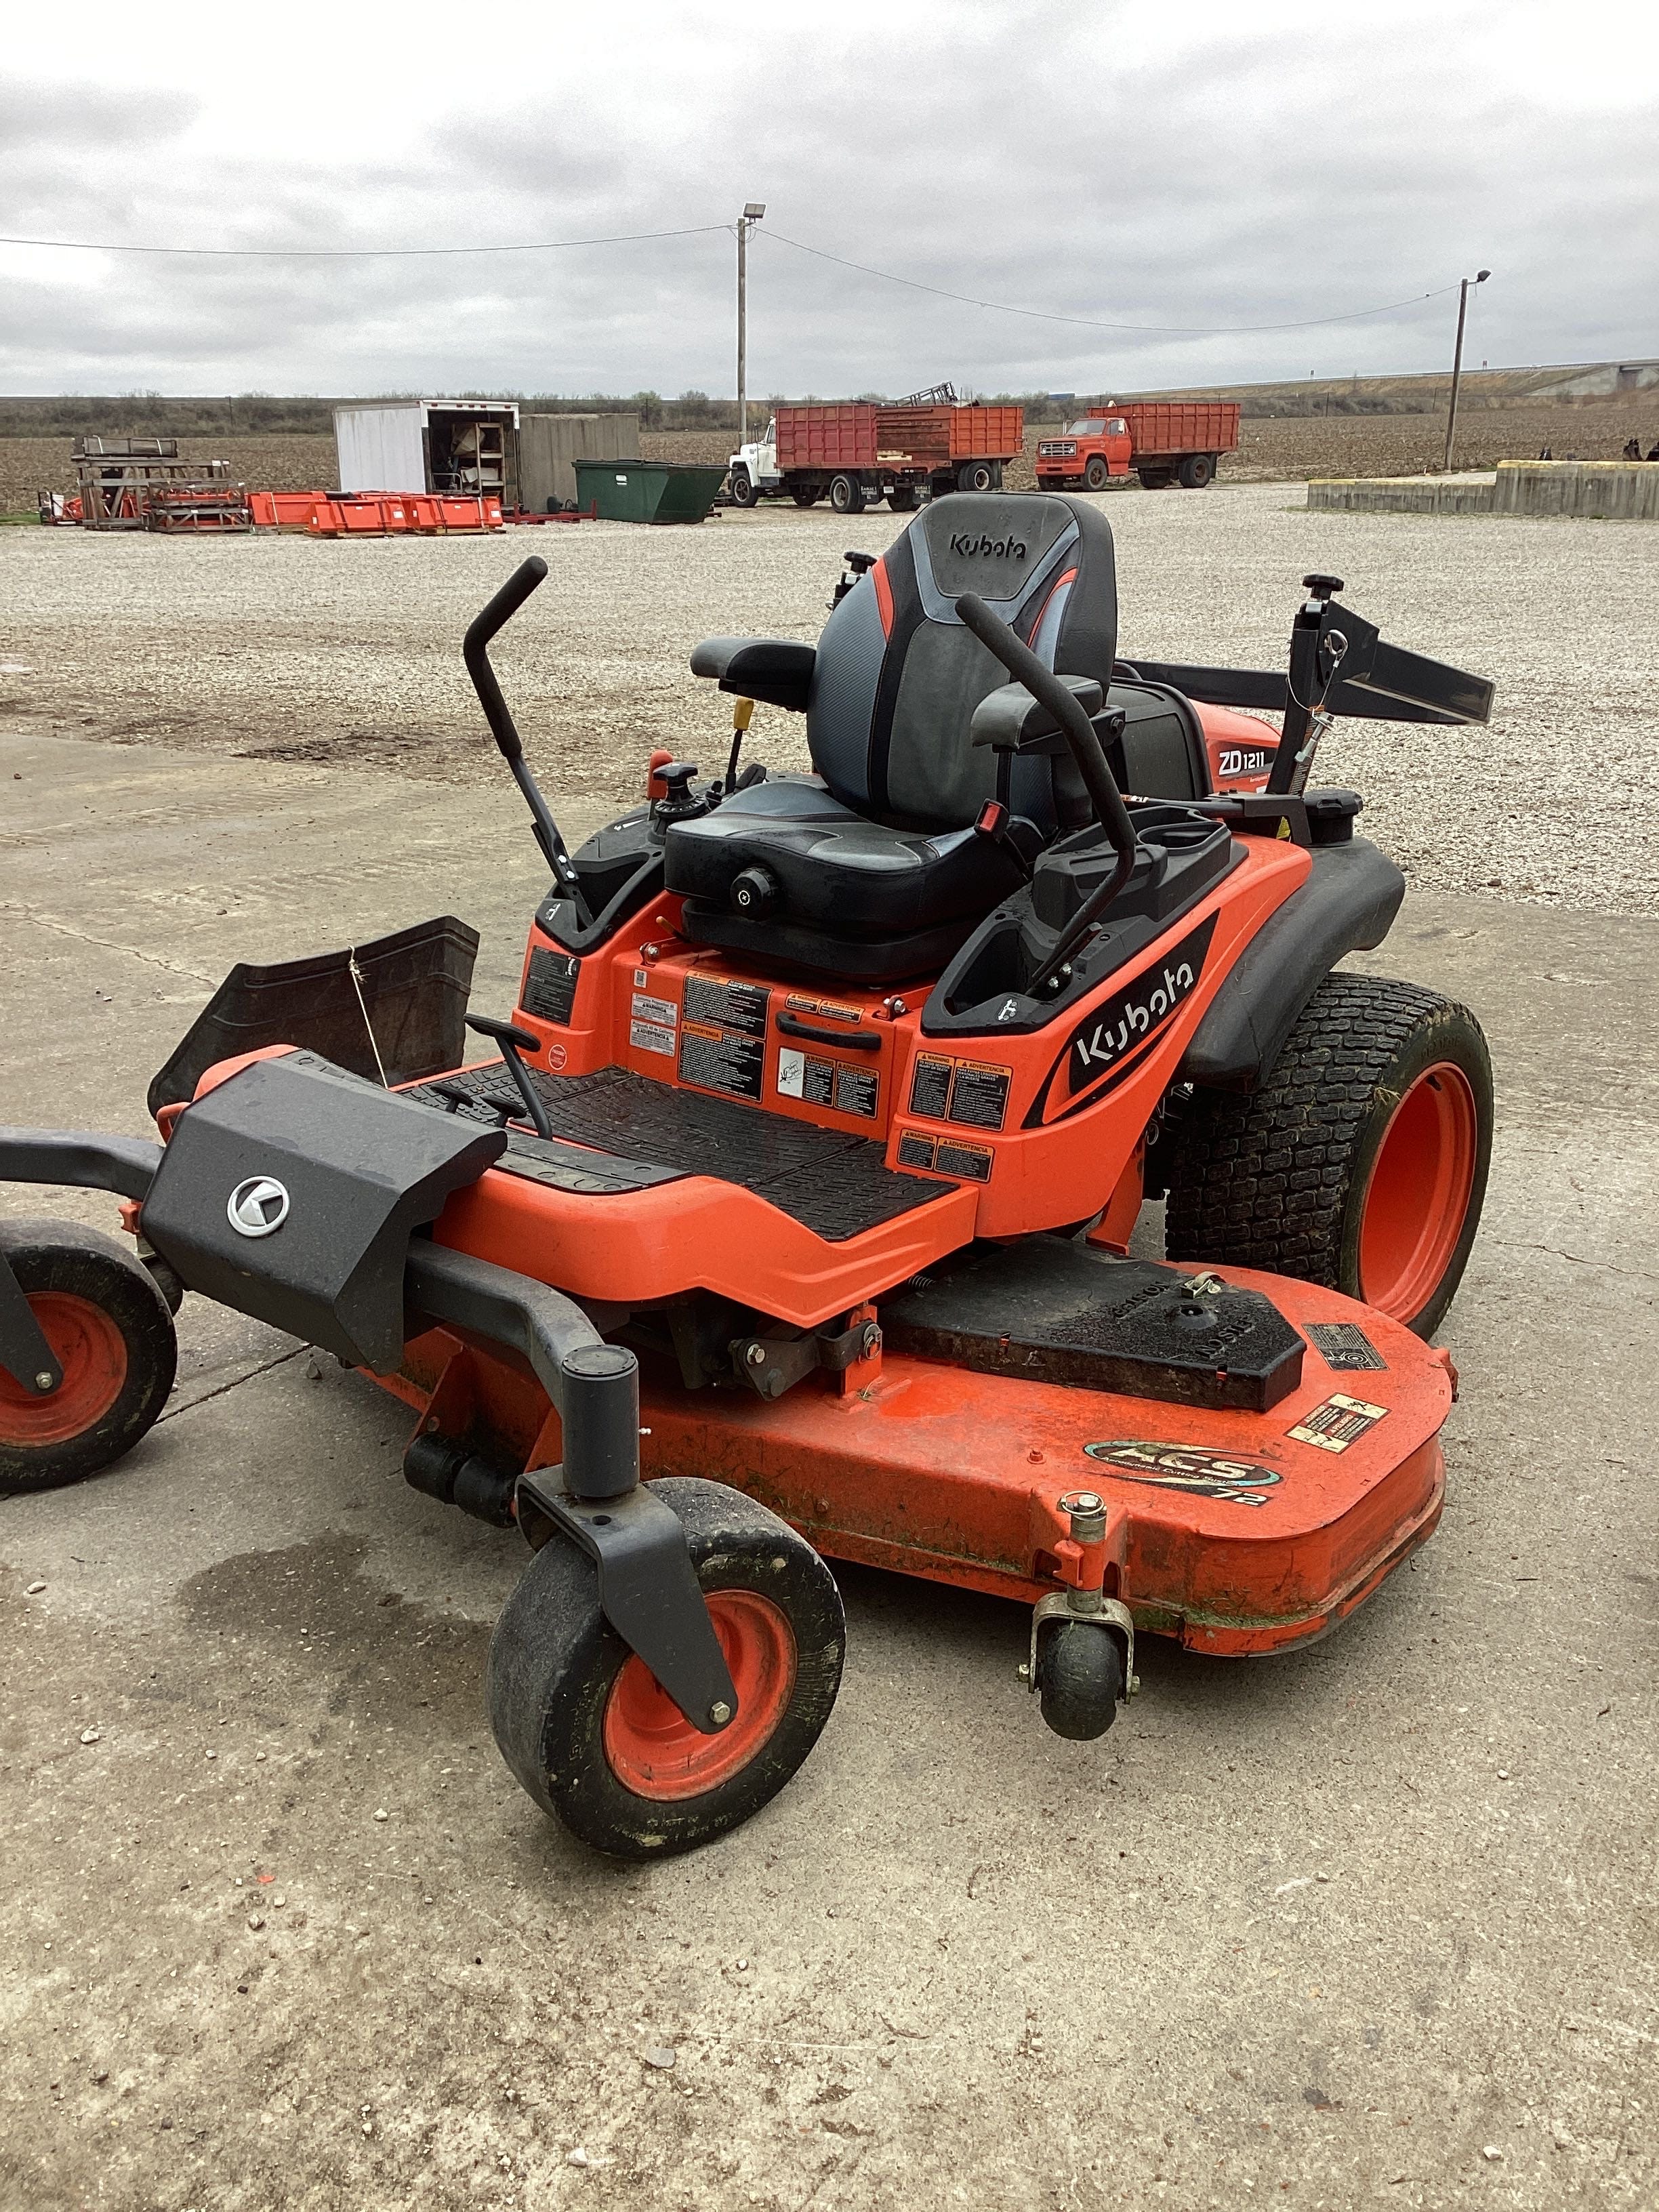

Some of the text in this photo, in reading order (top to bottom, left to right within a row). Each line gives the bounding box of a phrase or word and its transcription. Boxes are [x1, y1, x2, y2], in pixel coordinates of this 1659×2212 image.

[949, 533, 1027, 559] Kubota
[1218, 750, 1265, 775] ZD 1211
[1076, 963, 1194, 1065] Kubota
[811, 1056, 834, 1067] WARNING
[927, 1054, 949, 1063] WARNING
[842, 1064, 877, 1077] ADVERTENCIA
[968, 1063, 1004, 1073] ADVERTENCIA
[909, 1132, 933, 1142] WARNING
[948, 1141, 988, 1153] ADVERTENCIA
[1099, 1456, 1160, 1471] Aerodynamic
[1162, 1468, 1200, 1479] Cutting
[1109, 1447, 1256, 1479] ACS
[1211, 1488, 1267, 1507] 72
